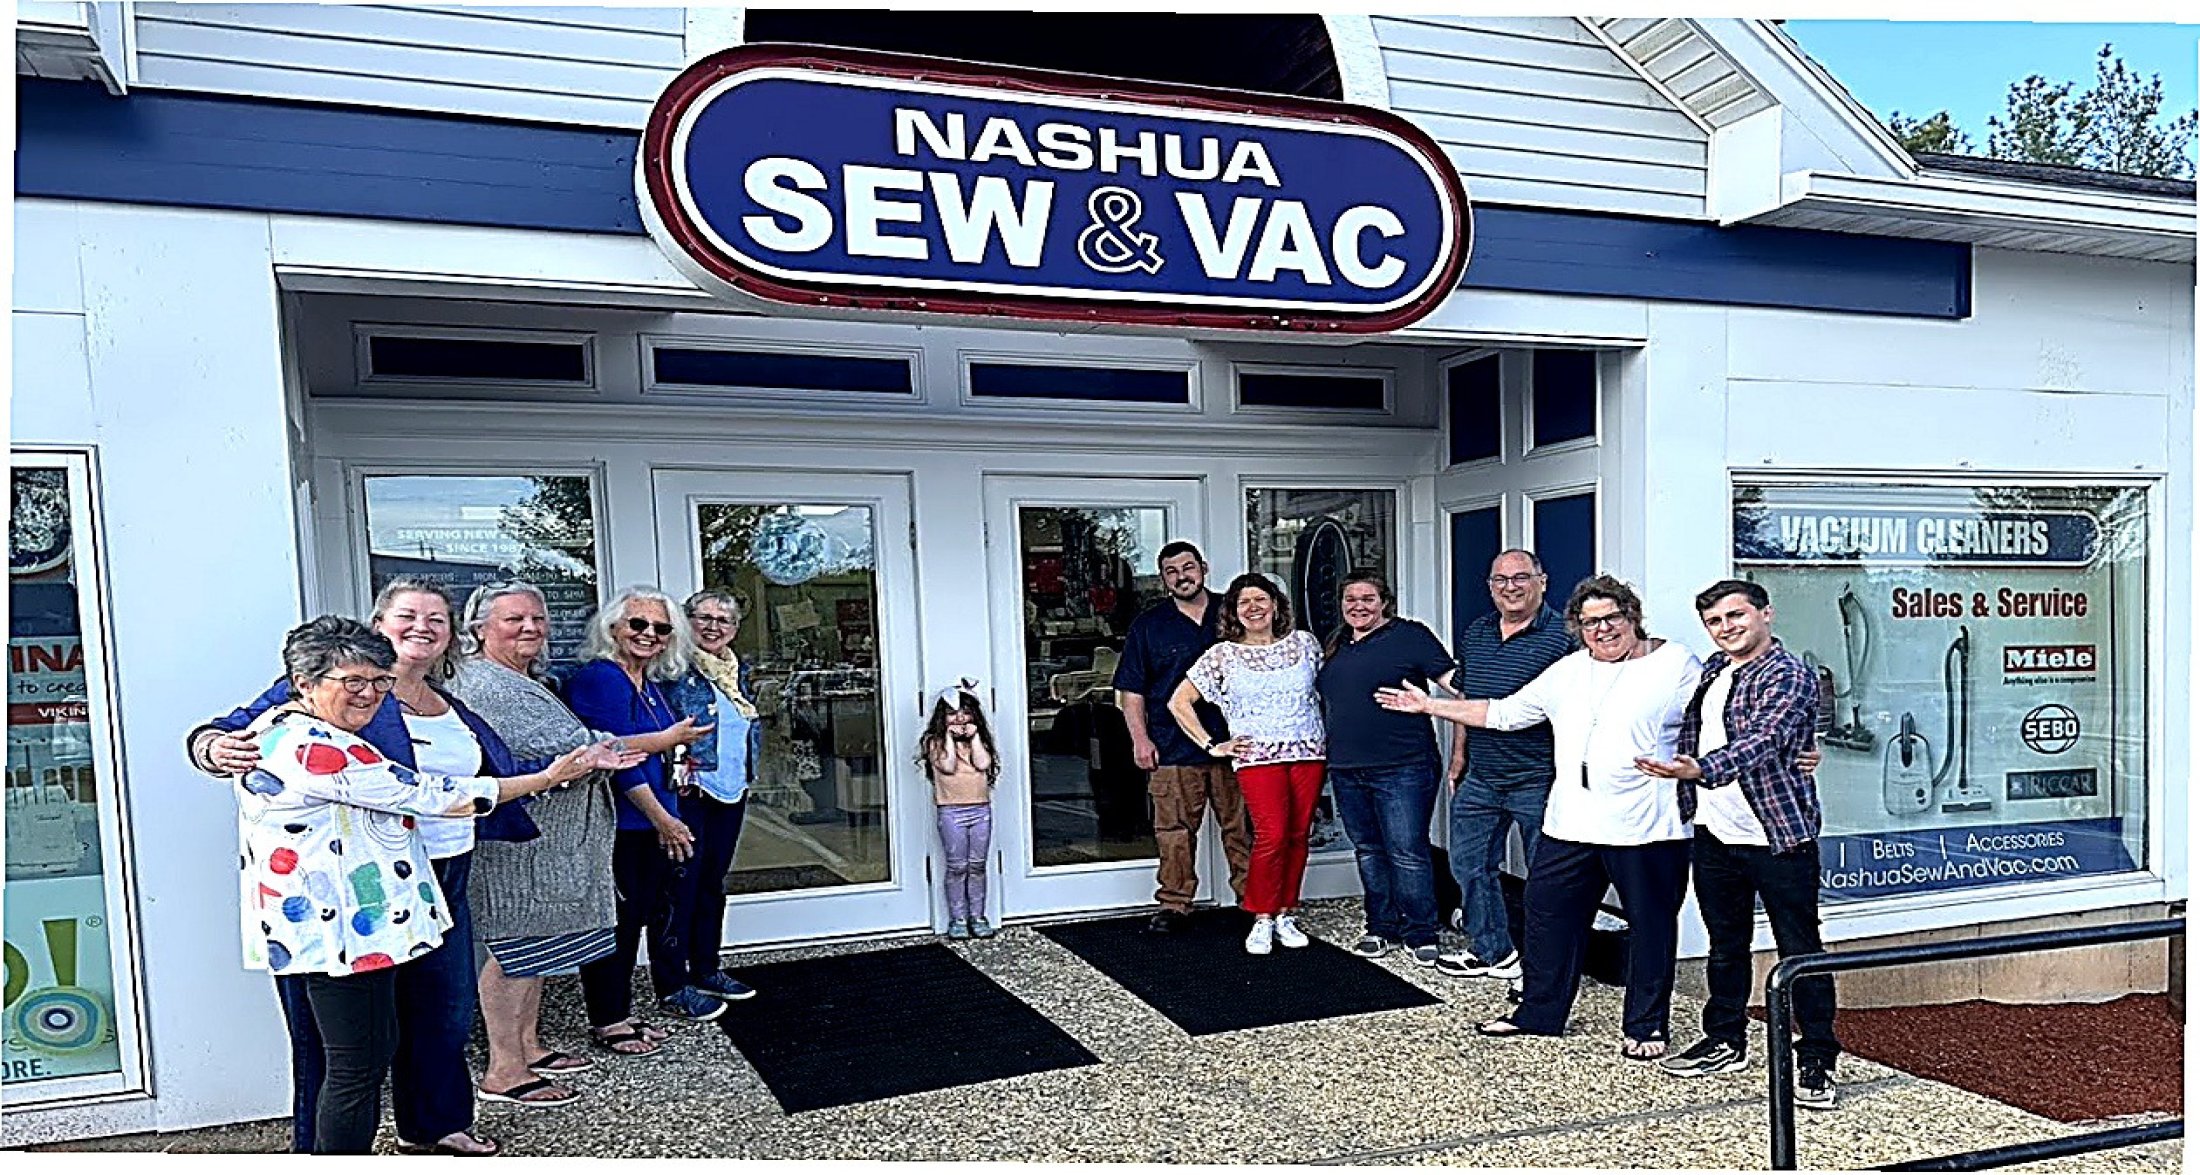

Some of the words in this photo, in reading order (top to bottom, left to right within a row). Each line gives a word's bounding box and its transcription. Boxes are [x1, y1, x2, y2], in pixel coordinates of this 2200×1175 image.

[894, 107, 1281, 188] NASHUA
[742, 156, 1053, 268] SEW
[1076, 186, 1166, 276] &
[1175, 191, 1406, 289] VAC
[397, 529, 459, 541] SERVING
[463, 529, 498, 541] NEW
[1780, 515, 1908, 555] VACUUM
[1916, 519, 2050, 556] CLEANERS
[446, 542, 487, 553] SINCE
[1891, 587, 1963, 619] Sales
[1970, 588, 1991, 618] &
[1996, 586, 2089, 618] Service
[2005, 647, 2094, 669] Miele
[17, 680, 39, 694] to
[2024, 720, 2078, 739] SEBO
[2030, 771, 2094, 797] RICCAR
